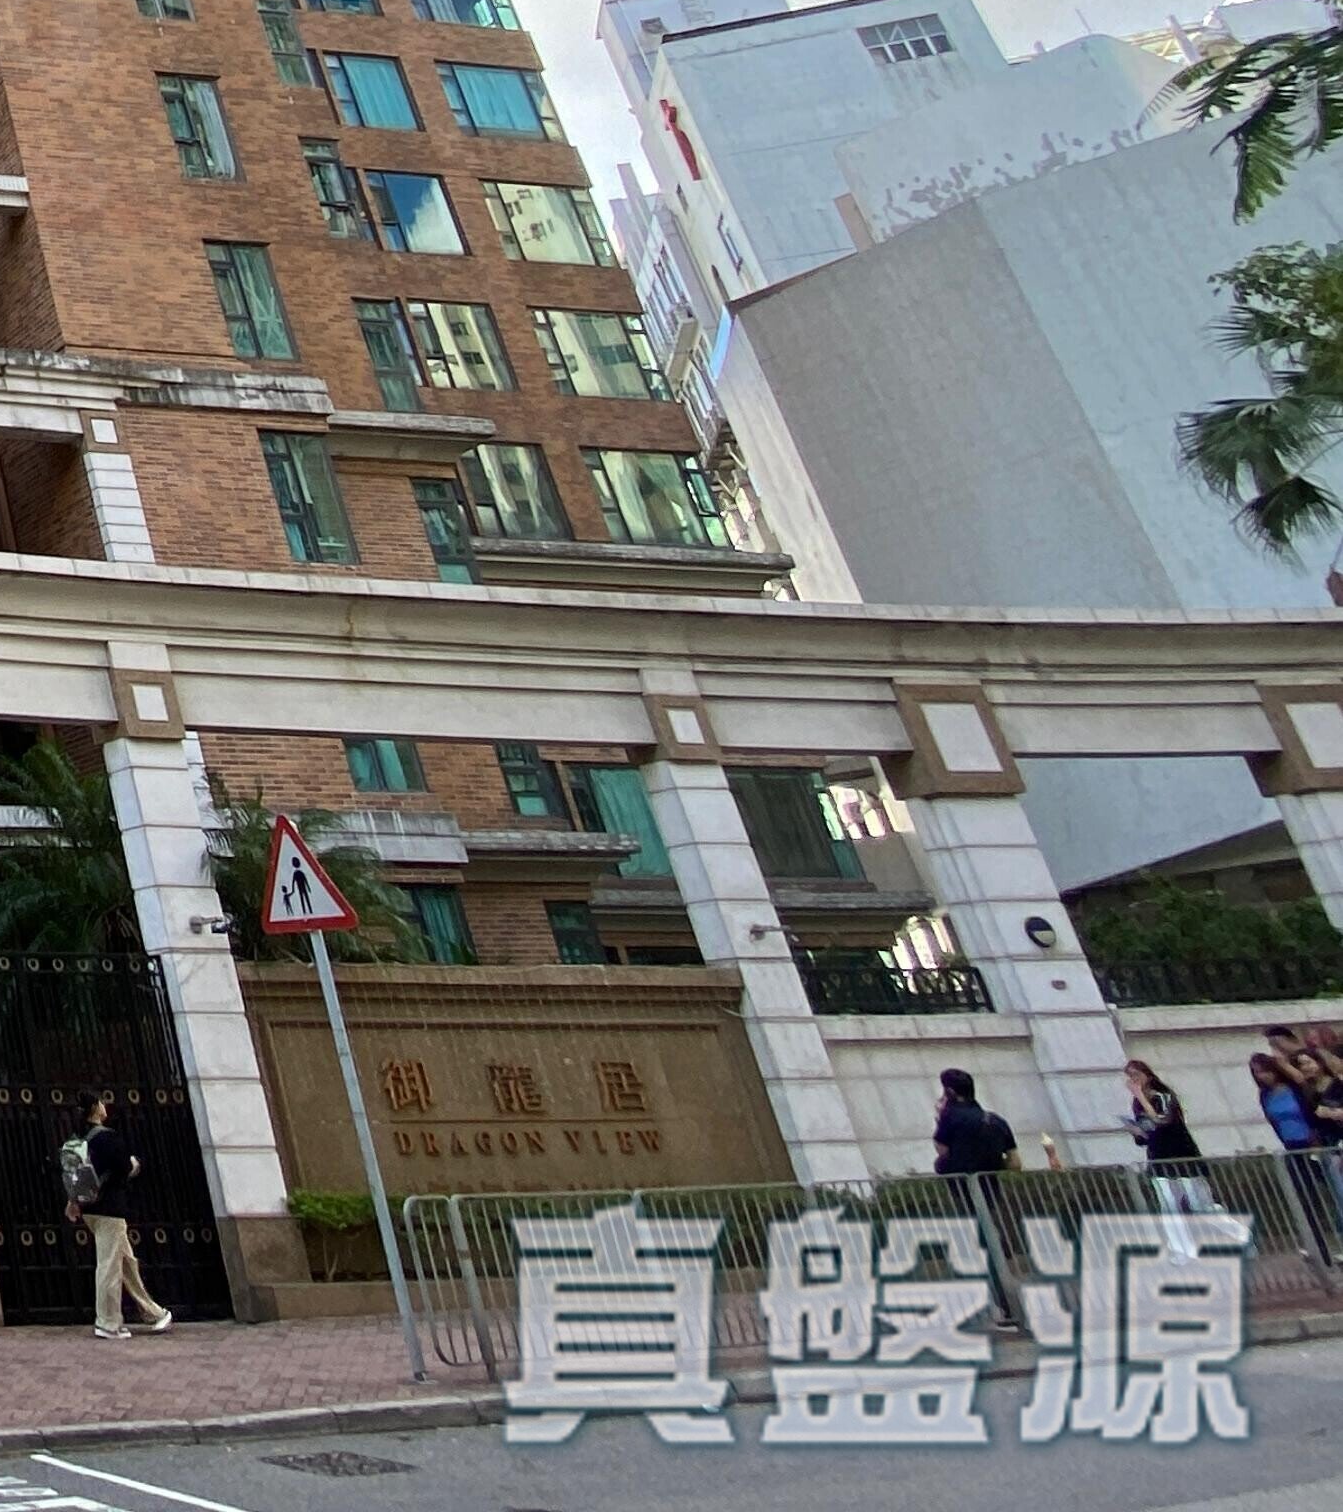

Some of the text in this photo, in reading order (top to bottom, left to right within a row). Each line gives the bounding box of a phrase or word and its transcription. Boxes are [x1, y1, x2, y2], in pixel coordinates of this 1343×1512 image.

[381, 1059, 645, 1113] 御龍居
[394, 1130, 662, 1155] DRAGON VIEW
